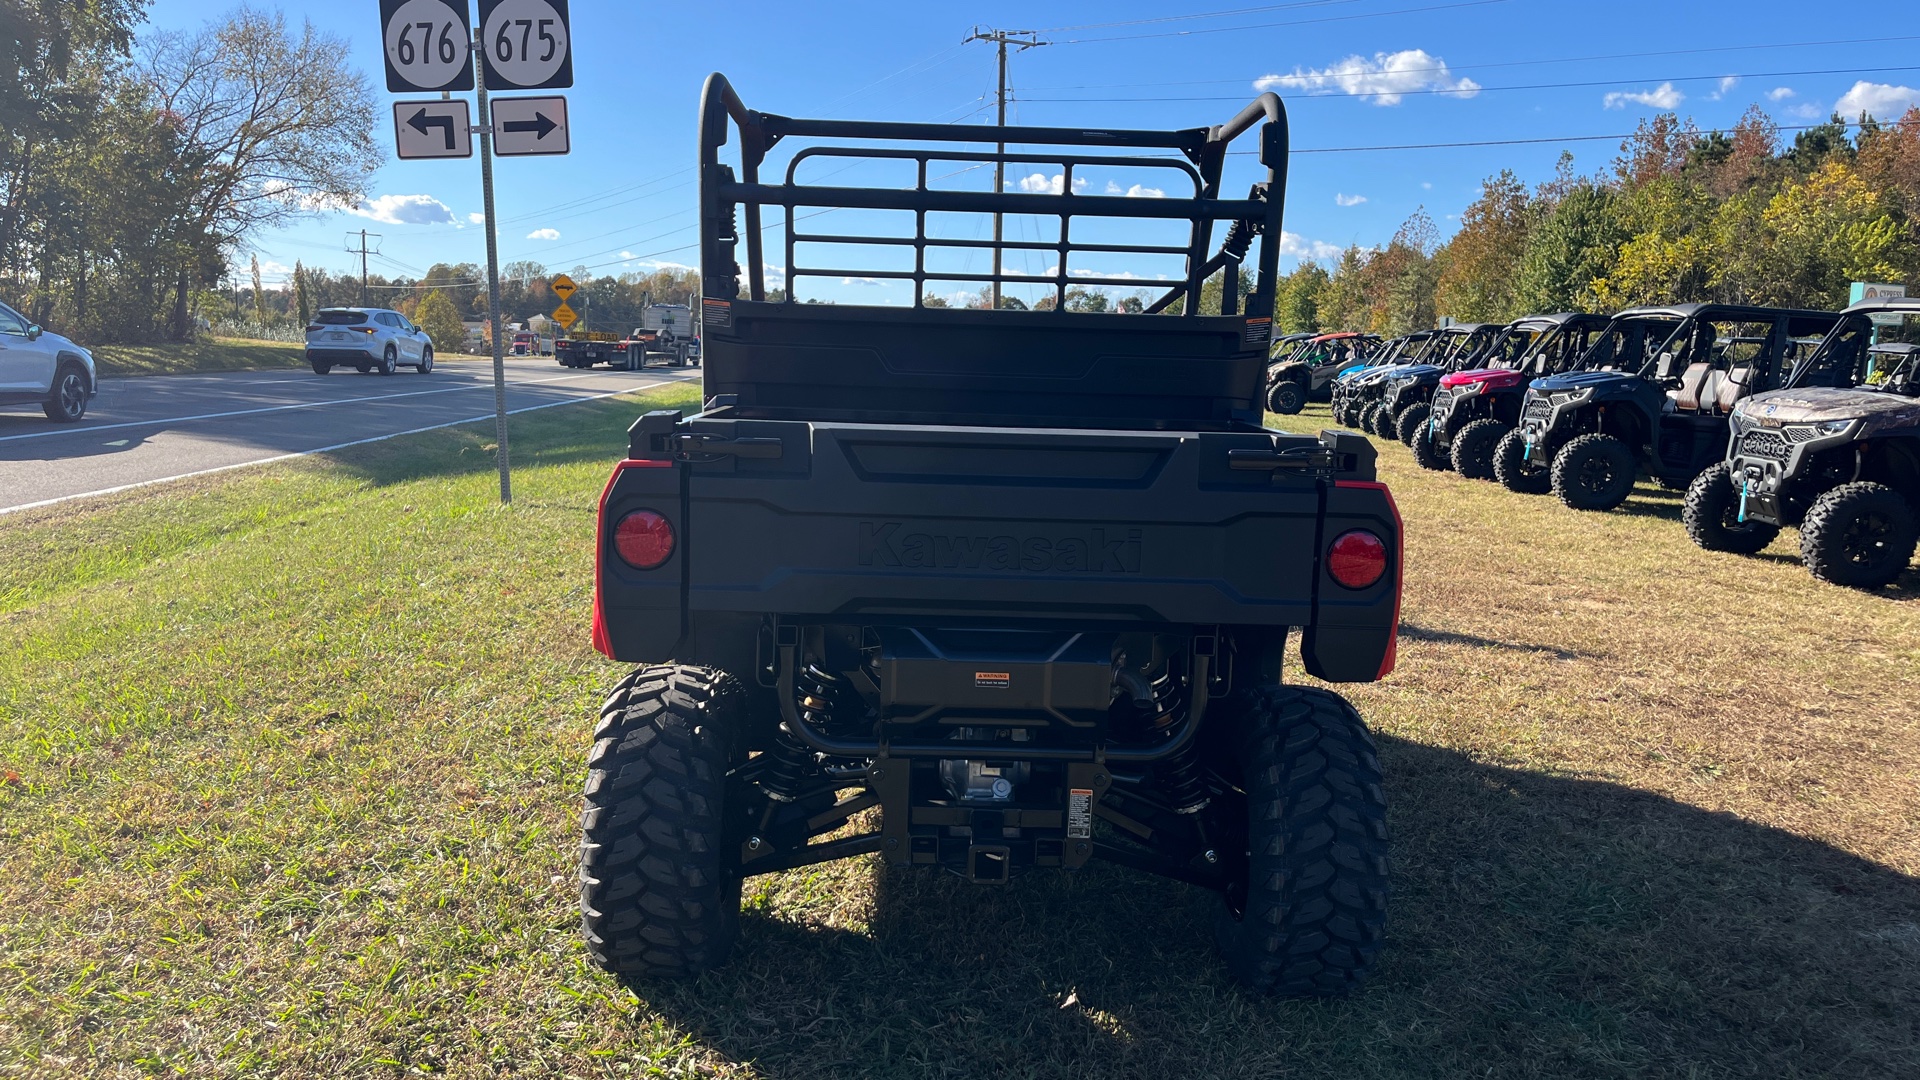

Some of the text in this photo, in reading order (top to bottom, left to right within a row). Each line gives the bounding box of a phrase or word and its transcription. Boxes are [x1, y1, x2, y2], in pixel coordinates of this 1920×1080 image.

[398, 21, 456, 66] 676
[495, 19, 556, 62] 675
[1880, 290, 1903, 298] CYPRESS
[595, 333, 618, 341] LOAD
[1743, 439, 1787, 455] CFMOTO
[858, 521, 1143, 573] Kawasaki
